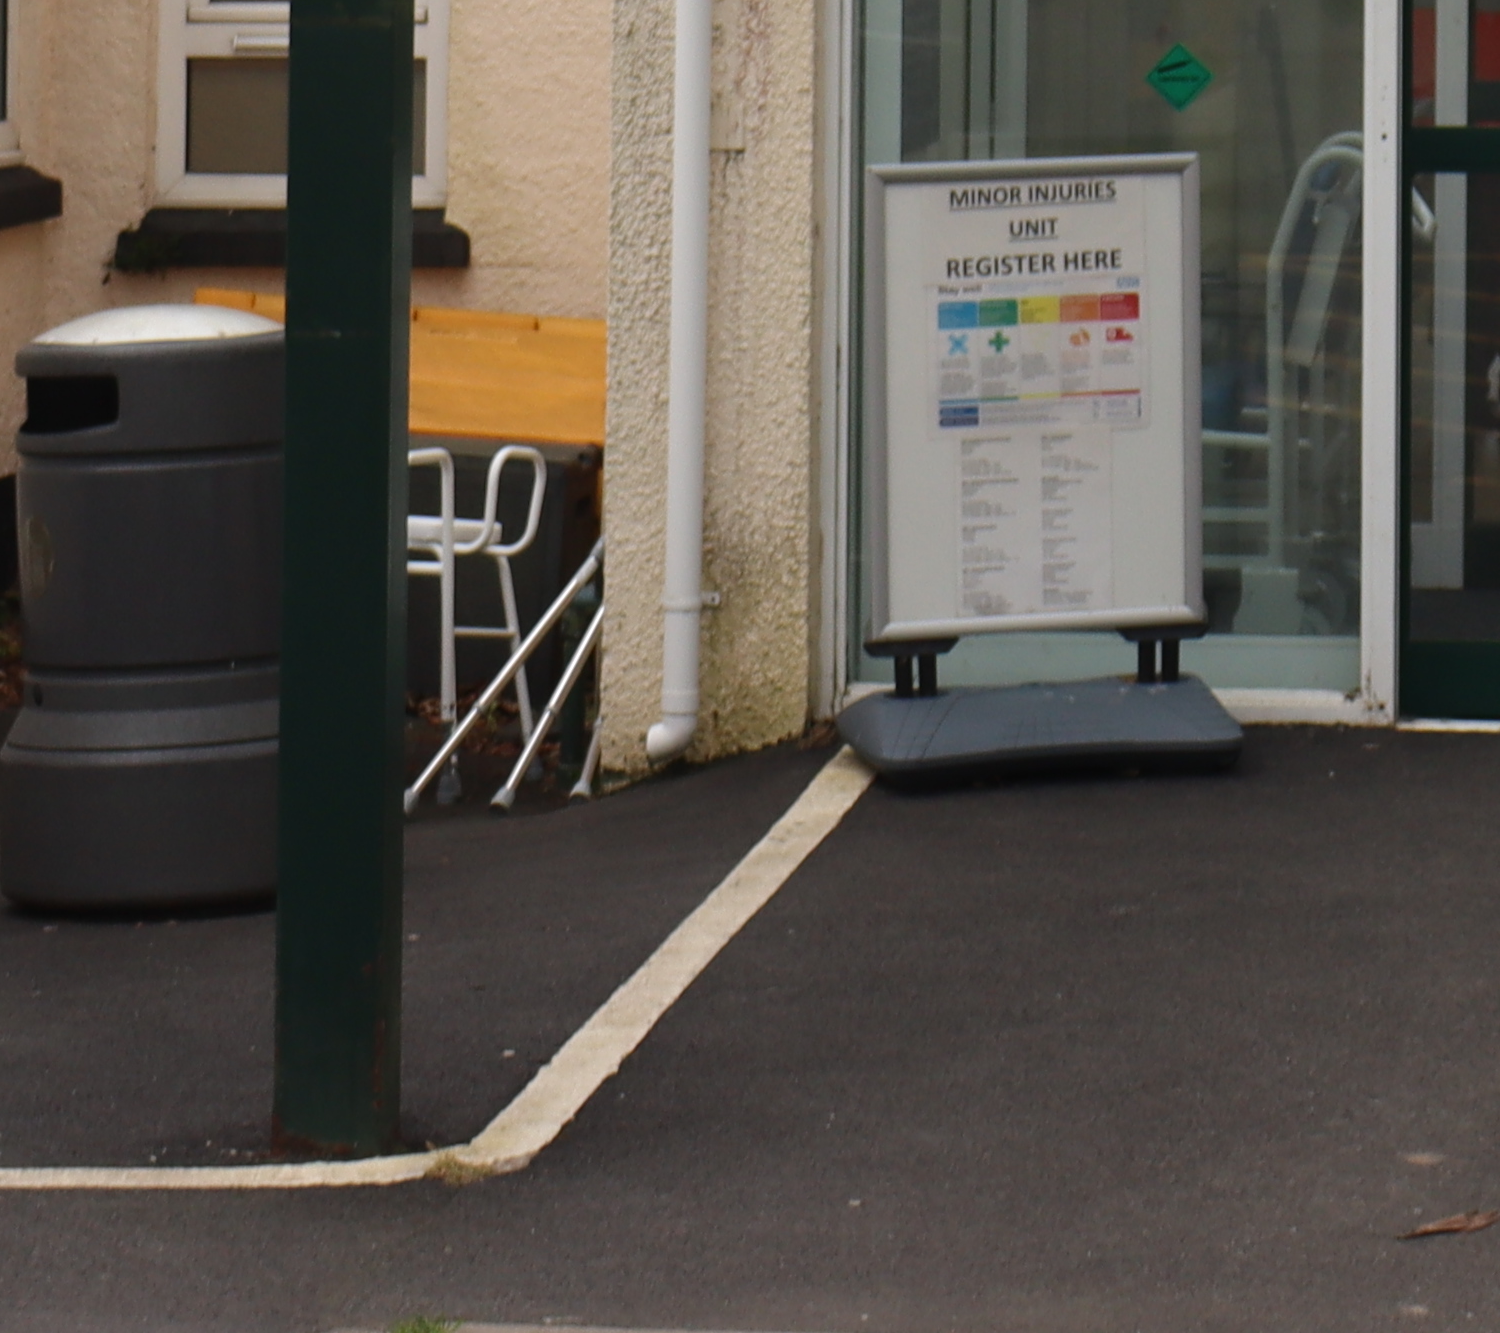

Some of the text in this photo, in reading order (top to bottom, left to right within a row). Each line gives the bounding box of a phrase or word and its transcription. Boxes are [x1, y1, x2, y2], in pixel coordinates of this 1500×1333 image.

[949, 180, 1117, 209] MINOR INJURIES
[1009, 218, 1058, 238] UNIT
[946, 249, 1122, 279] REGISTER HERE
